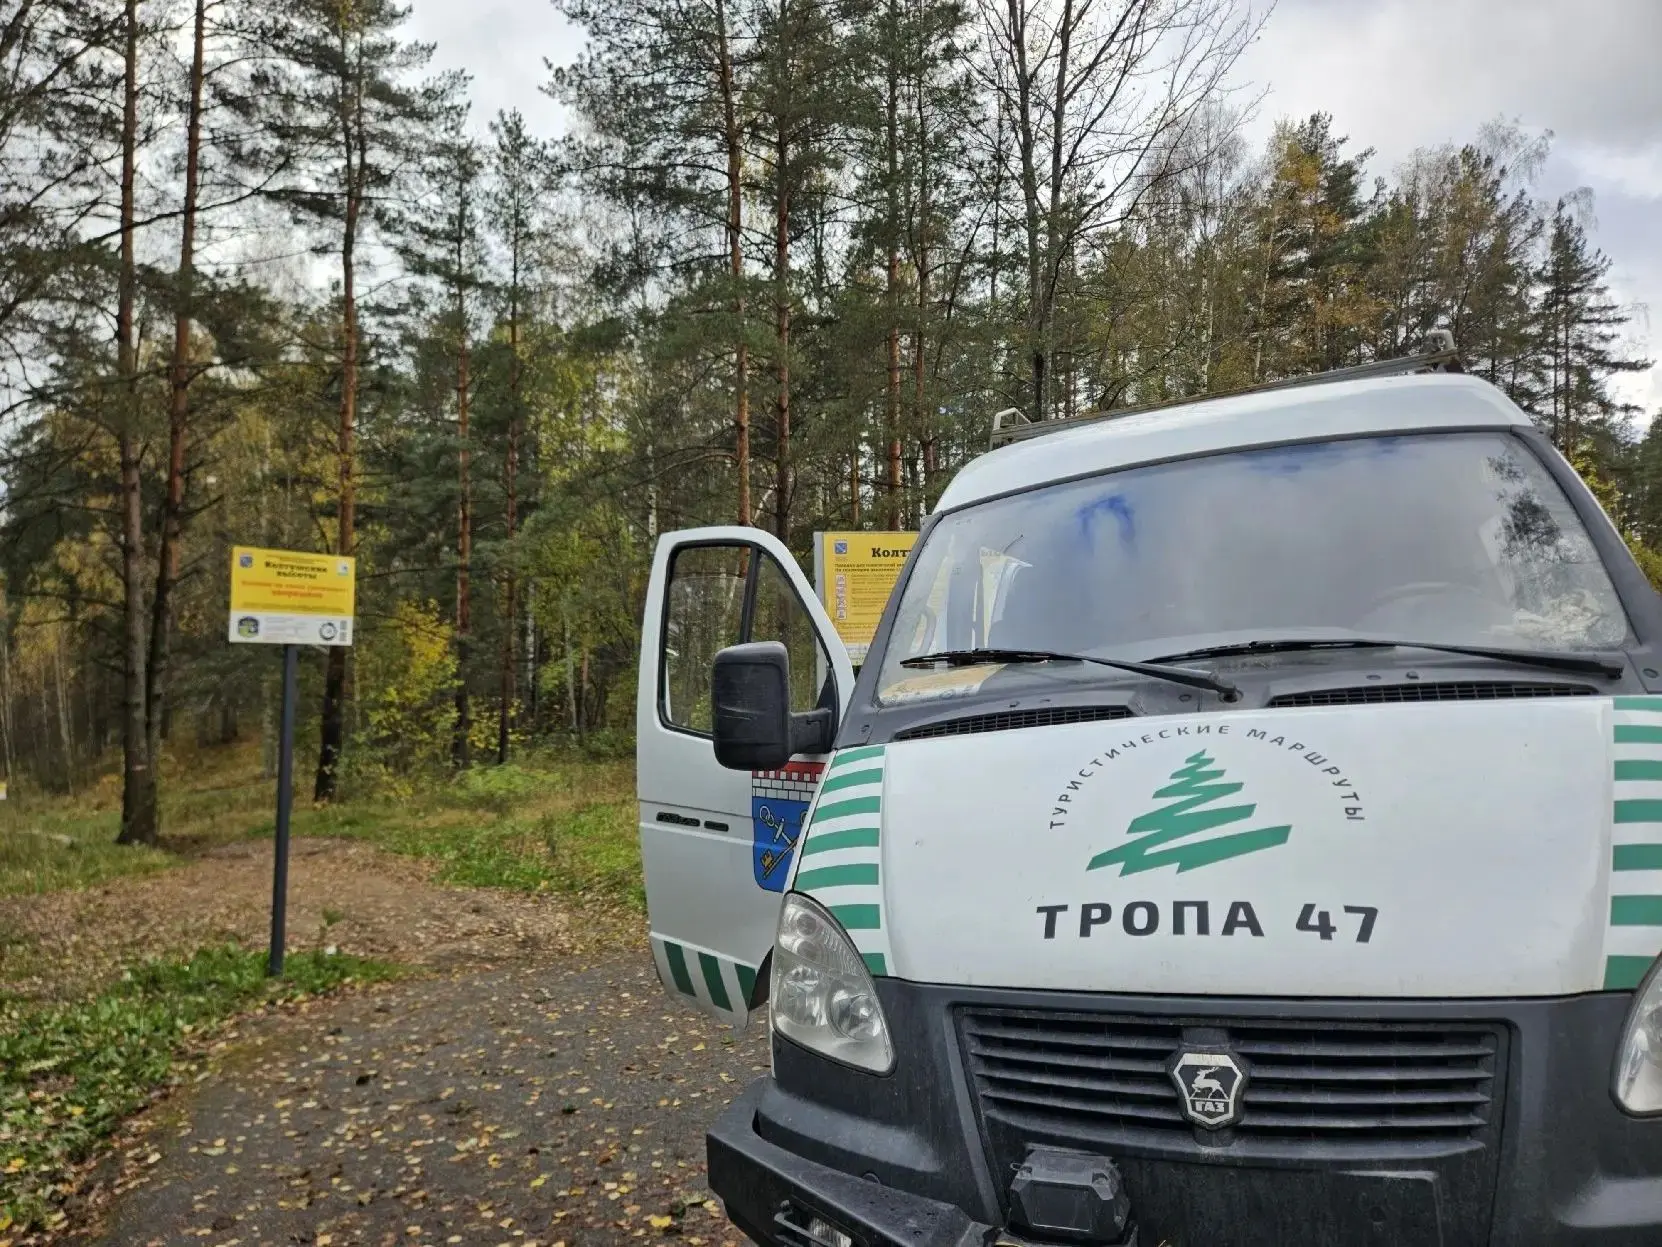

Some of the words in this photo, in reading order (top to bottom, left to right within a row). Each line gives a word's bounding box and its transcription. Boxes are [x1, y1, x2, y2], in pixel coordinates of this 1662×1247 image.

[871, 547, 912, 558] Колт
[1049, 725, 1230, 829] ТУРИСТИЧЕСКИЕ
[1246, 728, 1365, 821] МАРШРУТЫ
[1036, 900, 1265, 940] ТРОПА
[1294, 903, 1380, 943] 47
[1195, 1101, 1225, 1113] ГАЗ
